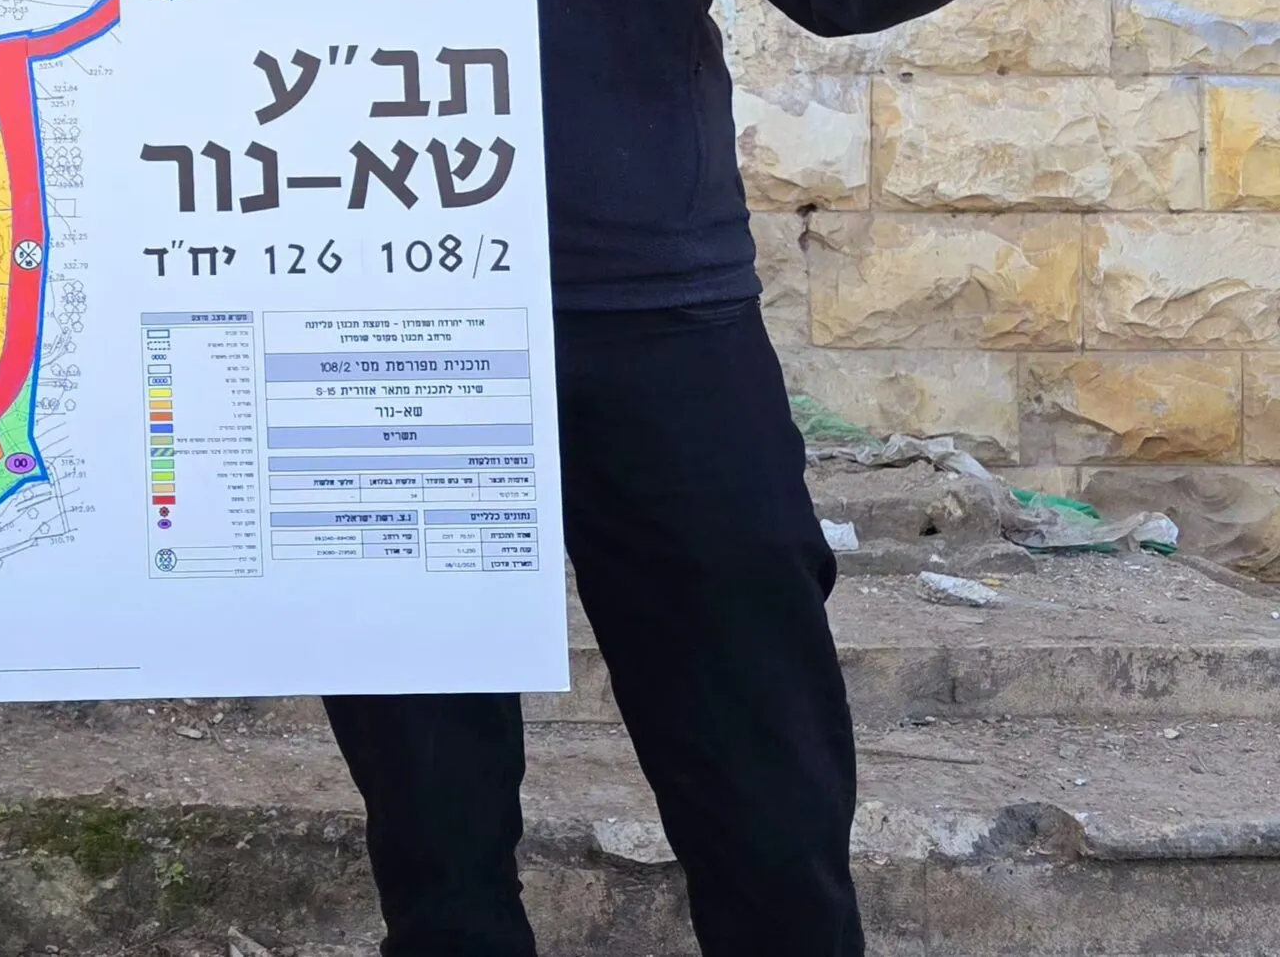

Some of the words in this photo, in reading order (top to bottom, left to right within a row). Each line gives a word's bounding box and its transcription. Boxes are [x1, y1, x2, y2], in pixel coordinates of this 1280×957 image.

[252, 43, 511, 126] תב"ע
[143, 238, 237, 277] יח"ד
[265, 238, 343, 274] 126
[381, 234, 511, 279] 108/2
[336, 321, 359, 330] תכנון
[362, 320, 390, 329] מועצת
[402, 320, 434, 329] ושומרון
[437, 319, 462, 328] יהודה
[466, 318, 485, 327] אזור
[340, 334, 369, 343] שומרון
[373, 334, 397, 342] מקומי
[401, 333, 424, 343] תכנון
[427, 333, 452, 342] מרחב
[320, 362, 351, 373] 108/2
[386, 360, 438, 372] מפורטת
[443, 358, 491, 371] תוכנית
[315, 387, 336, 397] S-15
[340, 386, 377, 396] אזורית
[380, 385, 411, 395] מתאר
[414, 384, 453, 395] לתכנית
[457, 384, 483, 394] שינוי
[374, 405, 423, 417] שא-נור
[382, 430, 417, 441] תשריט
[468, 457, 501, 467] וחלקות
[504, 456, 528, 465] גושים
[335, 514, 373, 524] ישראלית
[376, 514, 394, 523] רשת
[470, 512, 500, 522] כלליים
[503, 511, 530, 521] נתונים
